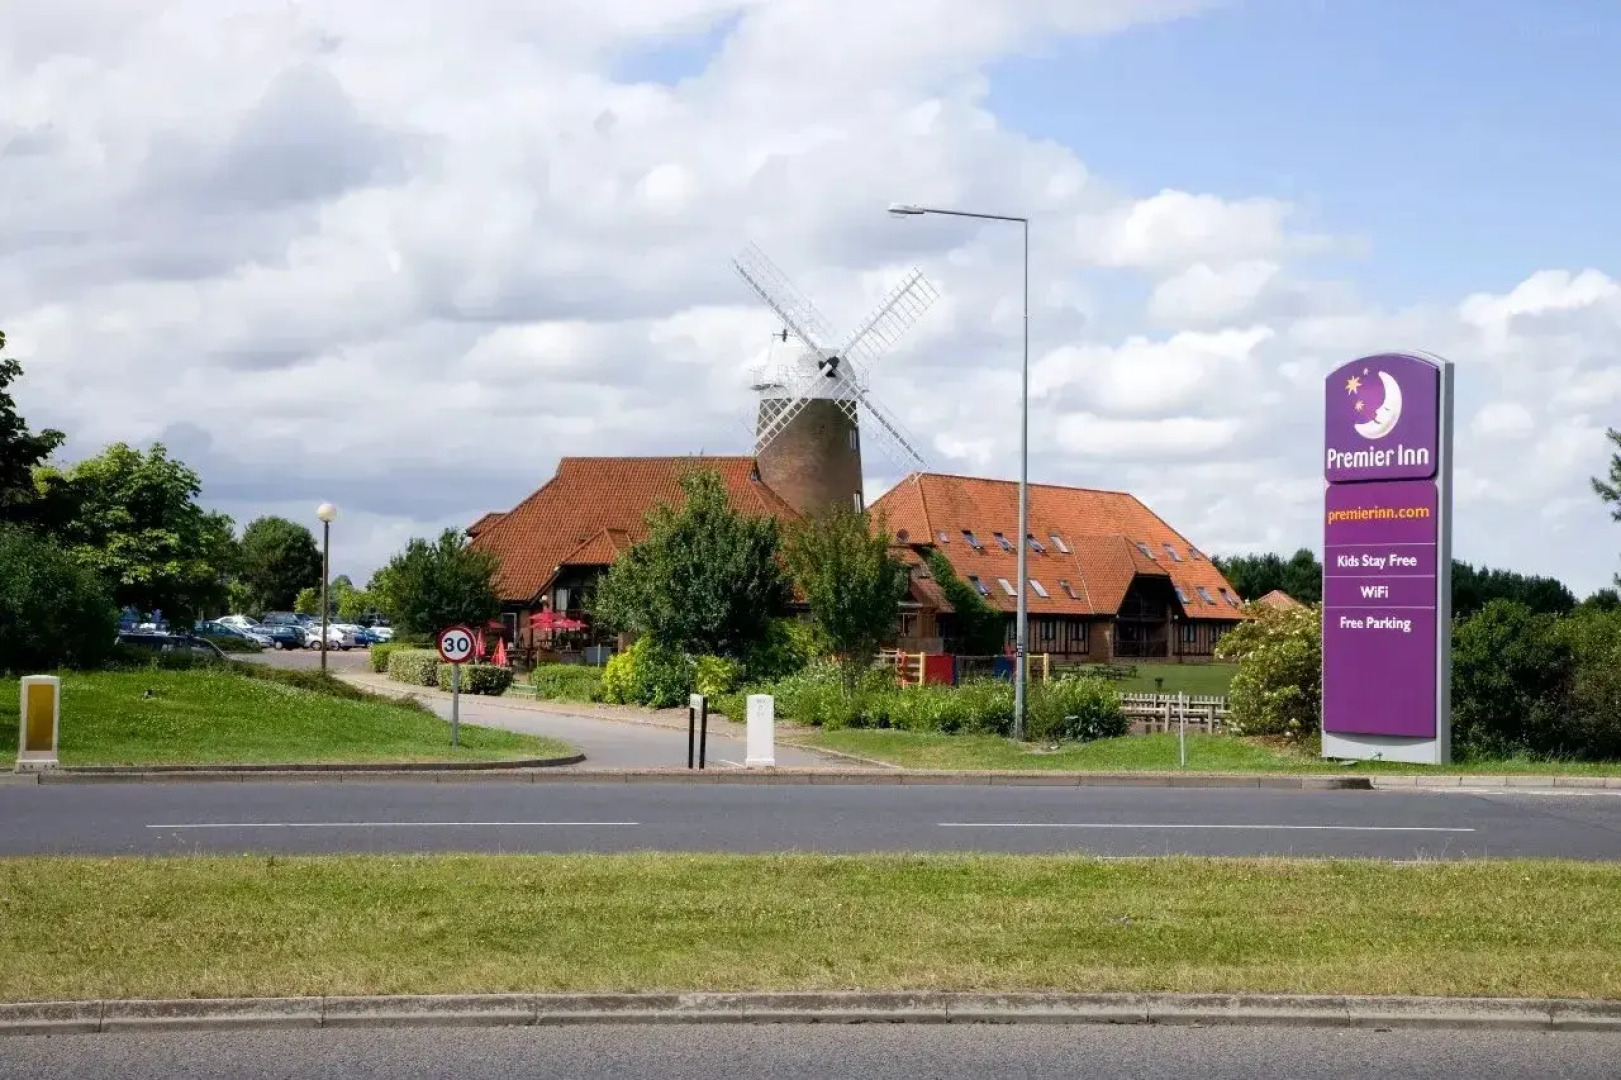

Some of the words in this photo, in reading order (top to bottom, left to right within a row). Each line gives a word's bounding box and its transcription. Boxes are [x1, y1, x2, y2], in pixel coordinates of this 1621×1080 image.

[1327, 446, 1394, 469] Premier
[1398, 444, 1429, 466] Inn
[1327, 505, 1430, 524] premierinn.com
[1337, 555, 1360, 567] Kids
[1361, 554, 1386, 569] Stay
[1389, 554, 1417, 566] Free
[1360, 586, 1388, 598] WiFi
[1340, 616, 1363, 629] Free
[1366, 615, 1411, 632] Parking
[444, 637, 469, 652] 30
